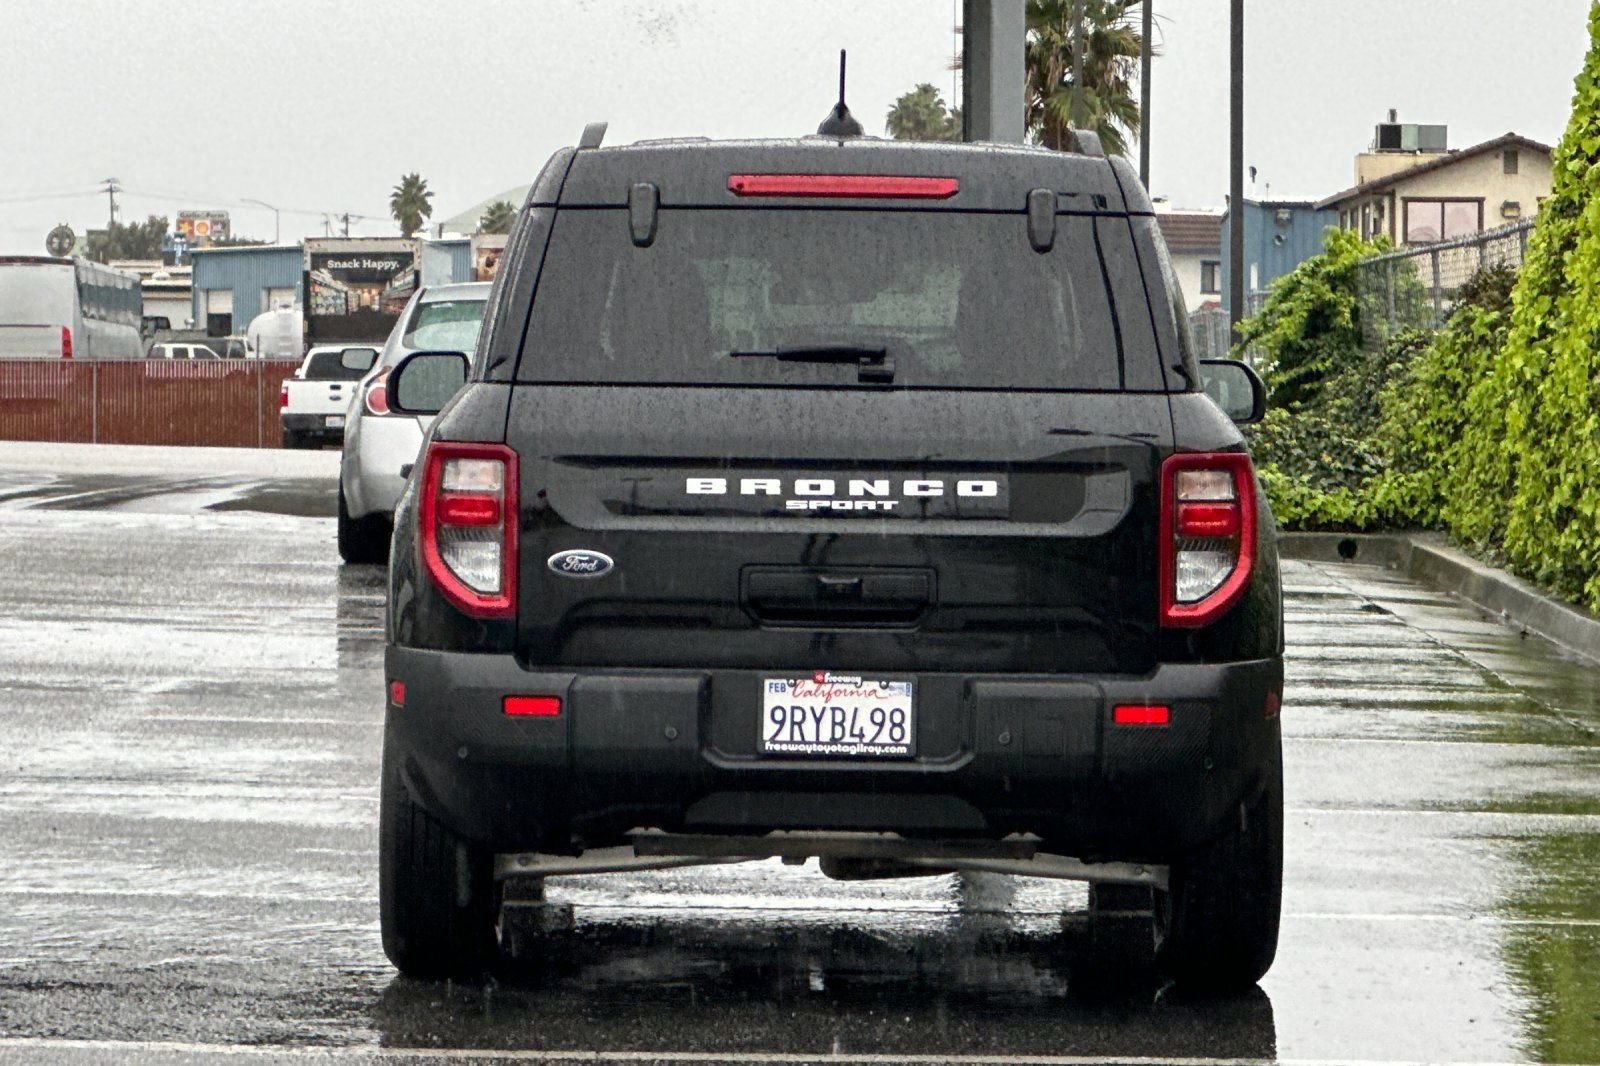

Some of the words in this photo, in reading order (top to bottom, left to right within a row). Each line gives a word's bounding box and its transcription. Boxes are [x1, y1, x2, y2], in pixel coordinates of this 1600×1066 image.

[327, 259, 359, 268] Snack
[362, 260, 399, 269] Happy.
[686, 478, 998, 496] BRONCO
[785, 500, 899, 510] SPORT
[562, 555, 598, 571] Ford
[824, 672, 862, 687] freeway
[768, 682, 786, 693] FEB
[791, 680, 889, 703] California
[769, 705, 906, 743] 9RYB498
[764, 741, 907, 755] freewaytoyotagilroy.com
